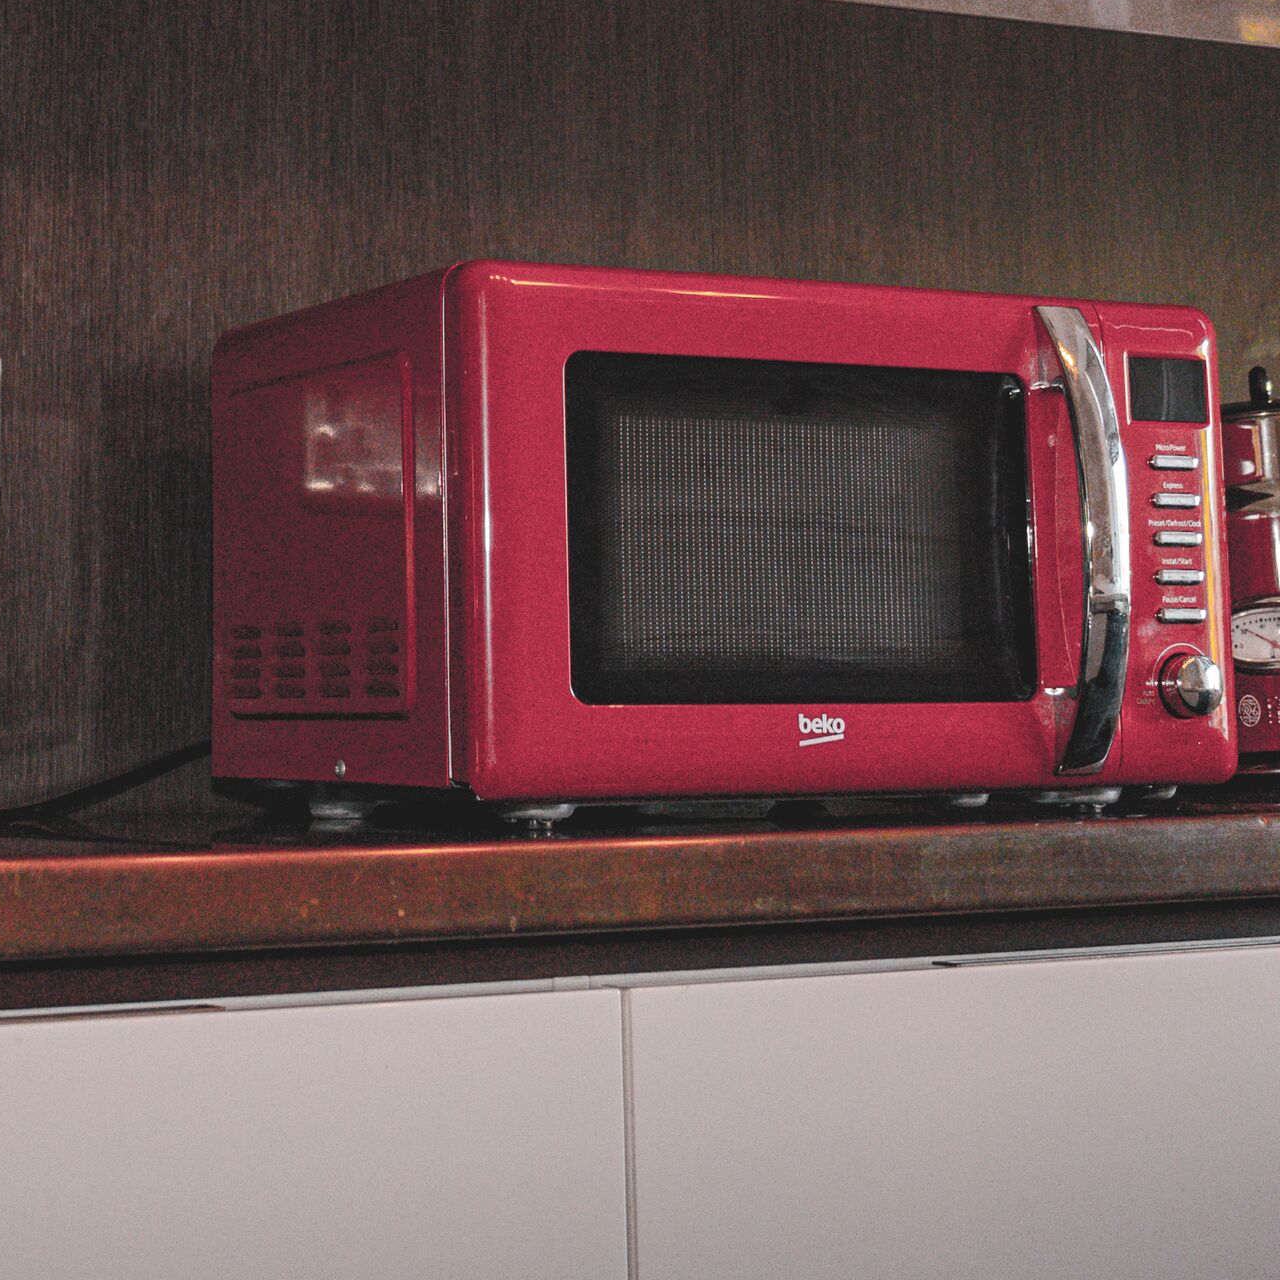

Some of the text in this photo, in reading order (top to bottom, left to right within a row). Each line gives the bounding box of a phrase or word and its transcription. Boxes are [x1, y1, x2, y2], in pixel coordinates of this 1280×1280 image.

[1162, 481, 1184, 490] Express
[1162, 595, 1196, 603] Pause/Cancel
[798, 713, 846, 734] beko
